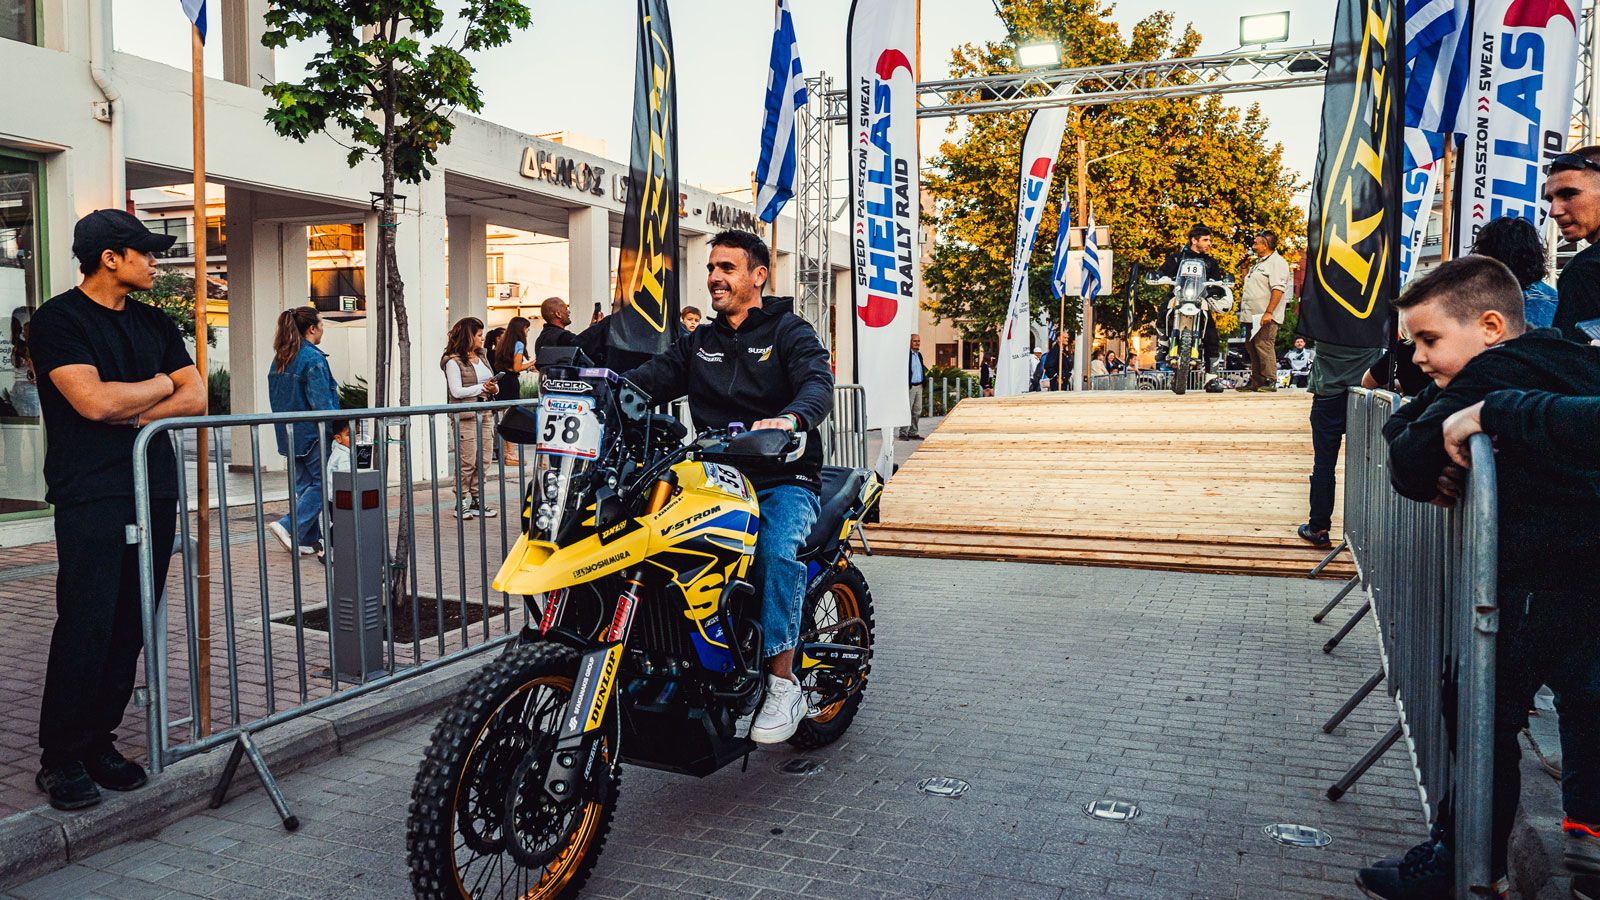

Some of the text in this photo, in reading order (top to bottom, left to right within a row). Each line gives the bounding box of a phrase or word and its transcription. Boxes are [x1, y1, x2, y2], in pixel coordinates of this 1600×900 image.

[1474, 32, 1495, 200] PASSION SWEAT
[1490, 32, 1545, 225] ELLAS
[519, 146, 606, 197] ΔΗΜΟΣ
[856, 76, 871, 287] SPEED PASSION SWEAT
[866, 78, 898, 295] HELLAS
[894, 158, 913, 298] RALLY RAID
[1186, 266, 1198, 274] 18
[543, 380, 593, 390] AURORA
[543, 414, 581, 444] 58
[660, 505, 721, 537] V-STROM
[586, 550, 631, 573] YOSHIMURA
[608, 595, 633, 643] OWA
[591, 650, 616, 725] DUNLOP
